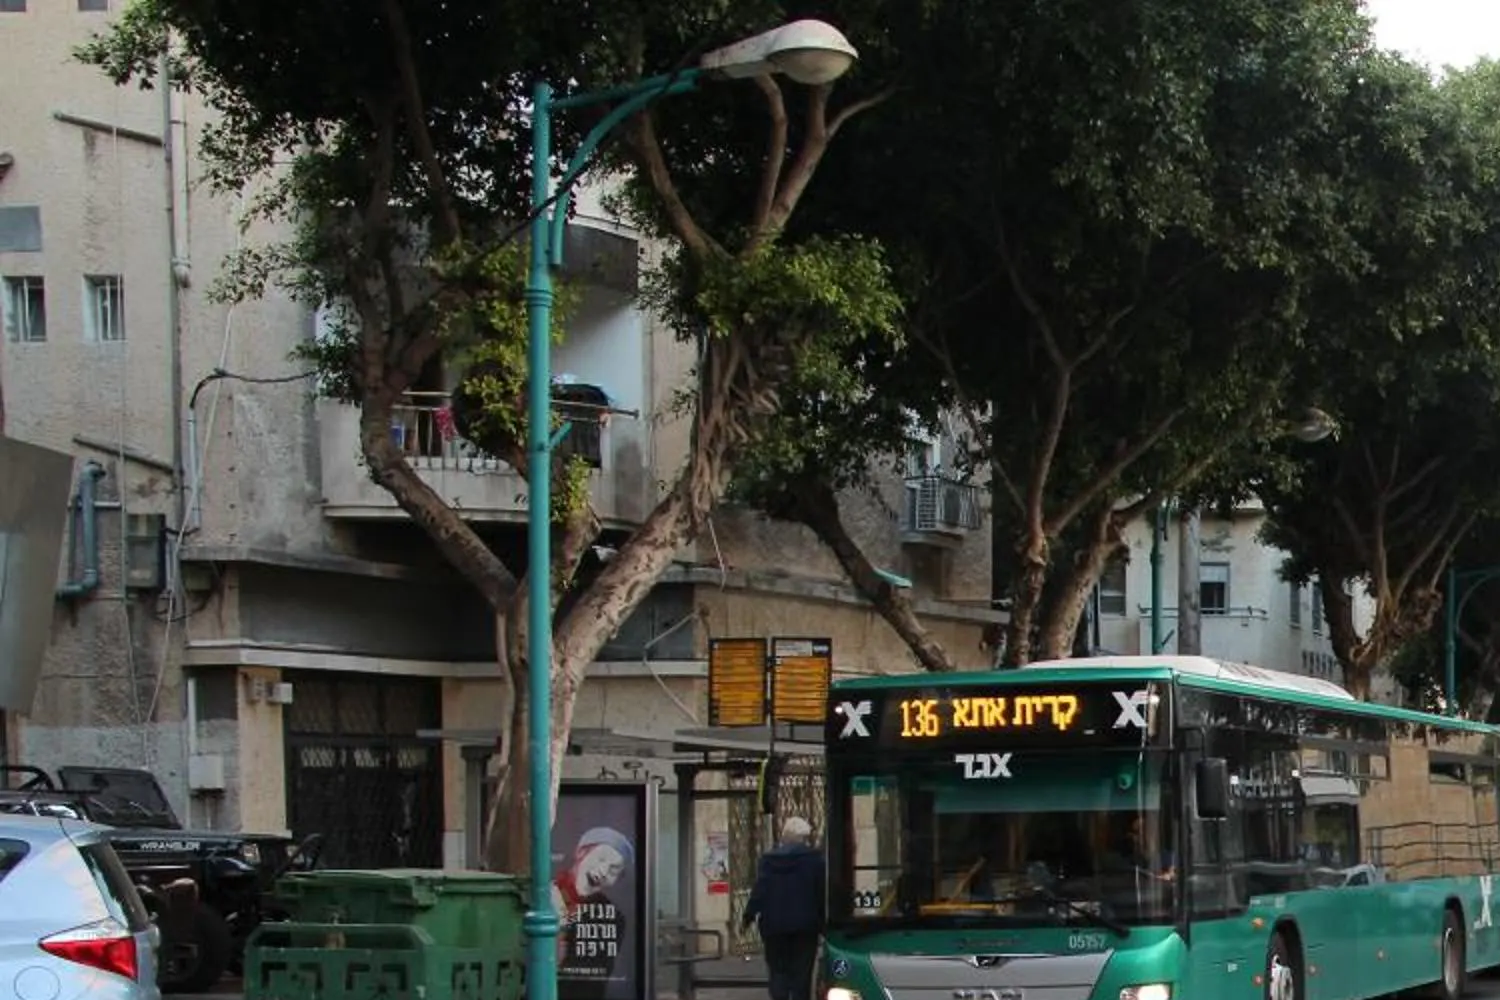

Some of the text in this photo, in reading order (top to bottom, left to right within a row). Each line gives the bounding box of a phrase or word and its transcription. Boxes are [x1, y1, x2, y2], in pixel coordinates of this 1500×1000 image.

[900, 696, 1078, 737] קרית אתא 136
[955, 752, 1013, 779] אגד
[854, 895, 881, 907] 136
[577, 903, 616, 922] מגזין
[576, 923, 617, 939] תרבות
[576, 941, 617, 957] חיפה
